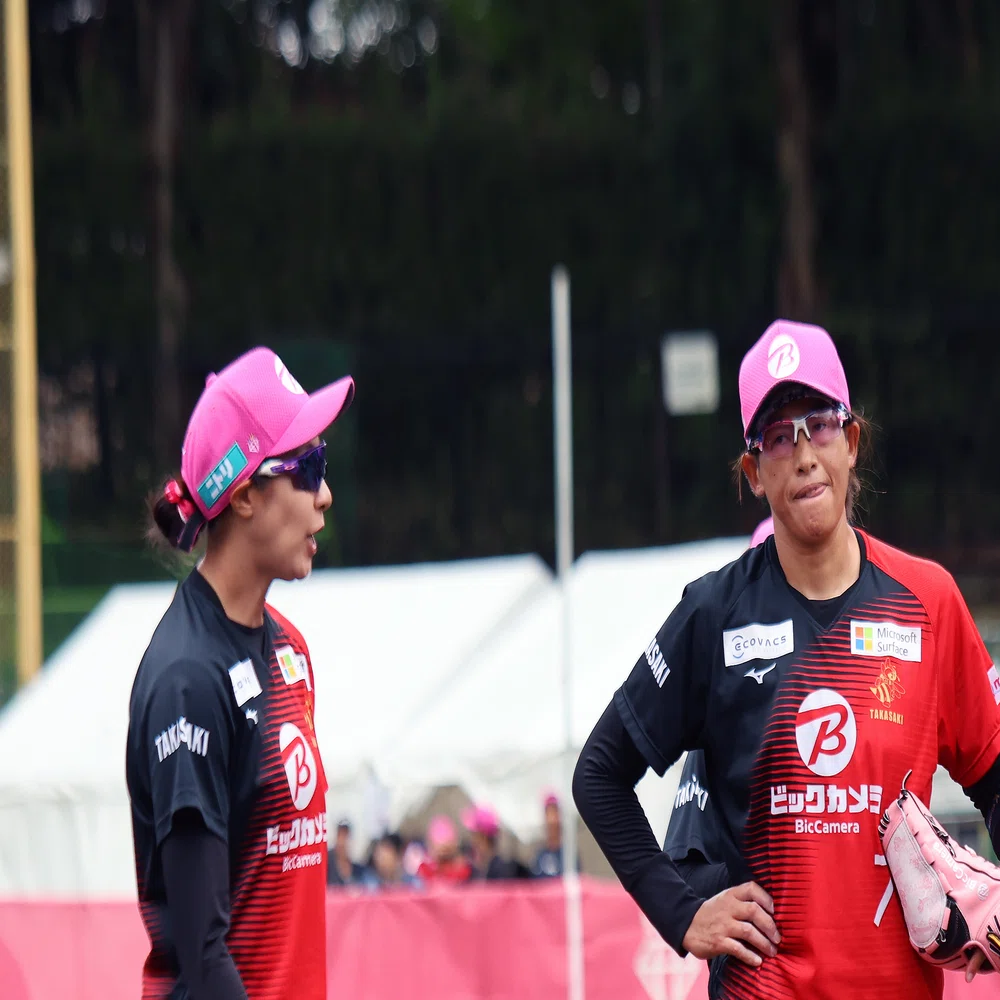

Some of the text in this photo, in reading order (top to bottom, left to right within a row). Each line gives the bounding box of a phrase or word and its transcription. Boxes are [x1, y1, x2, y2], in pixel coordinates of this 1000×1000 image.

[205, 458, 234, 500] ニトリ
[877, 627, 917, 644] Microsoft
[877, 641, 909, 656] Surface
[869, 709, 904, 725] TAKASAKI
[770, 784, 882, 815] ビックカメラ
[795, 819, 860, 834] BicCamera
